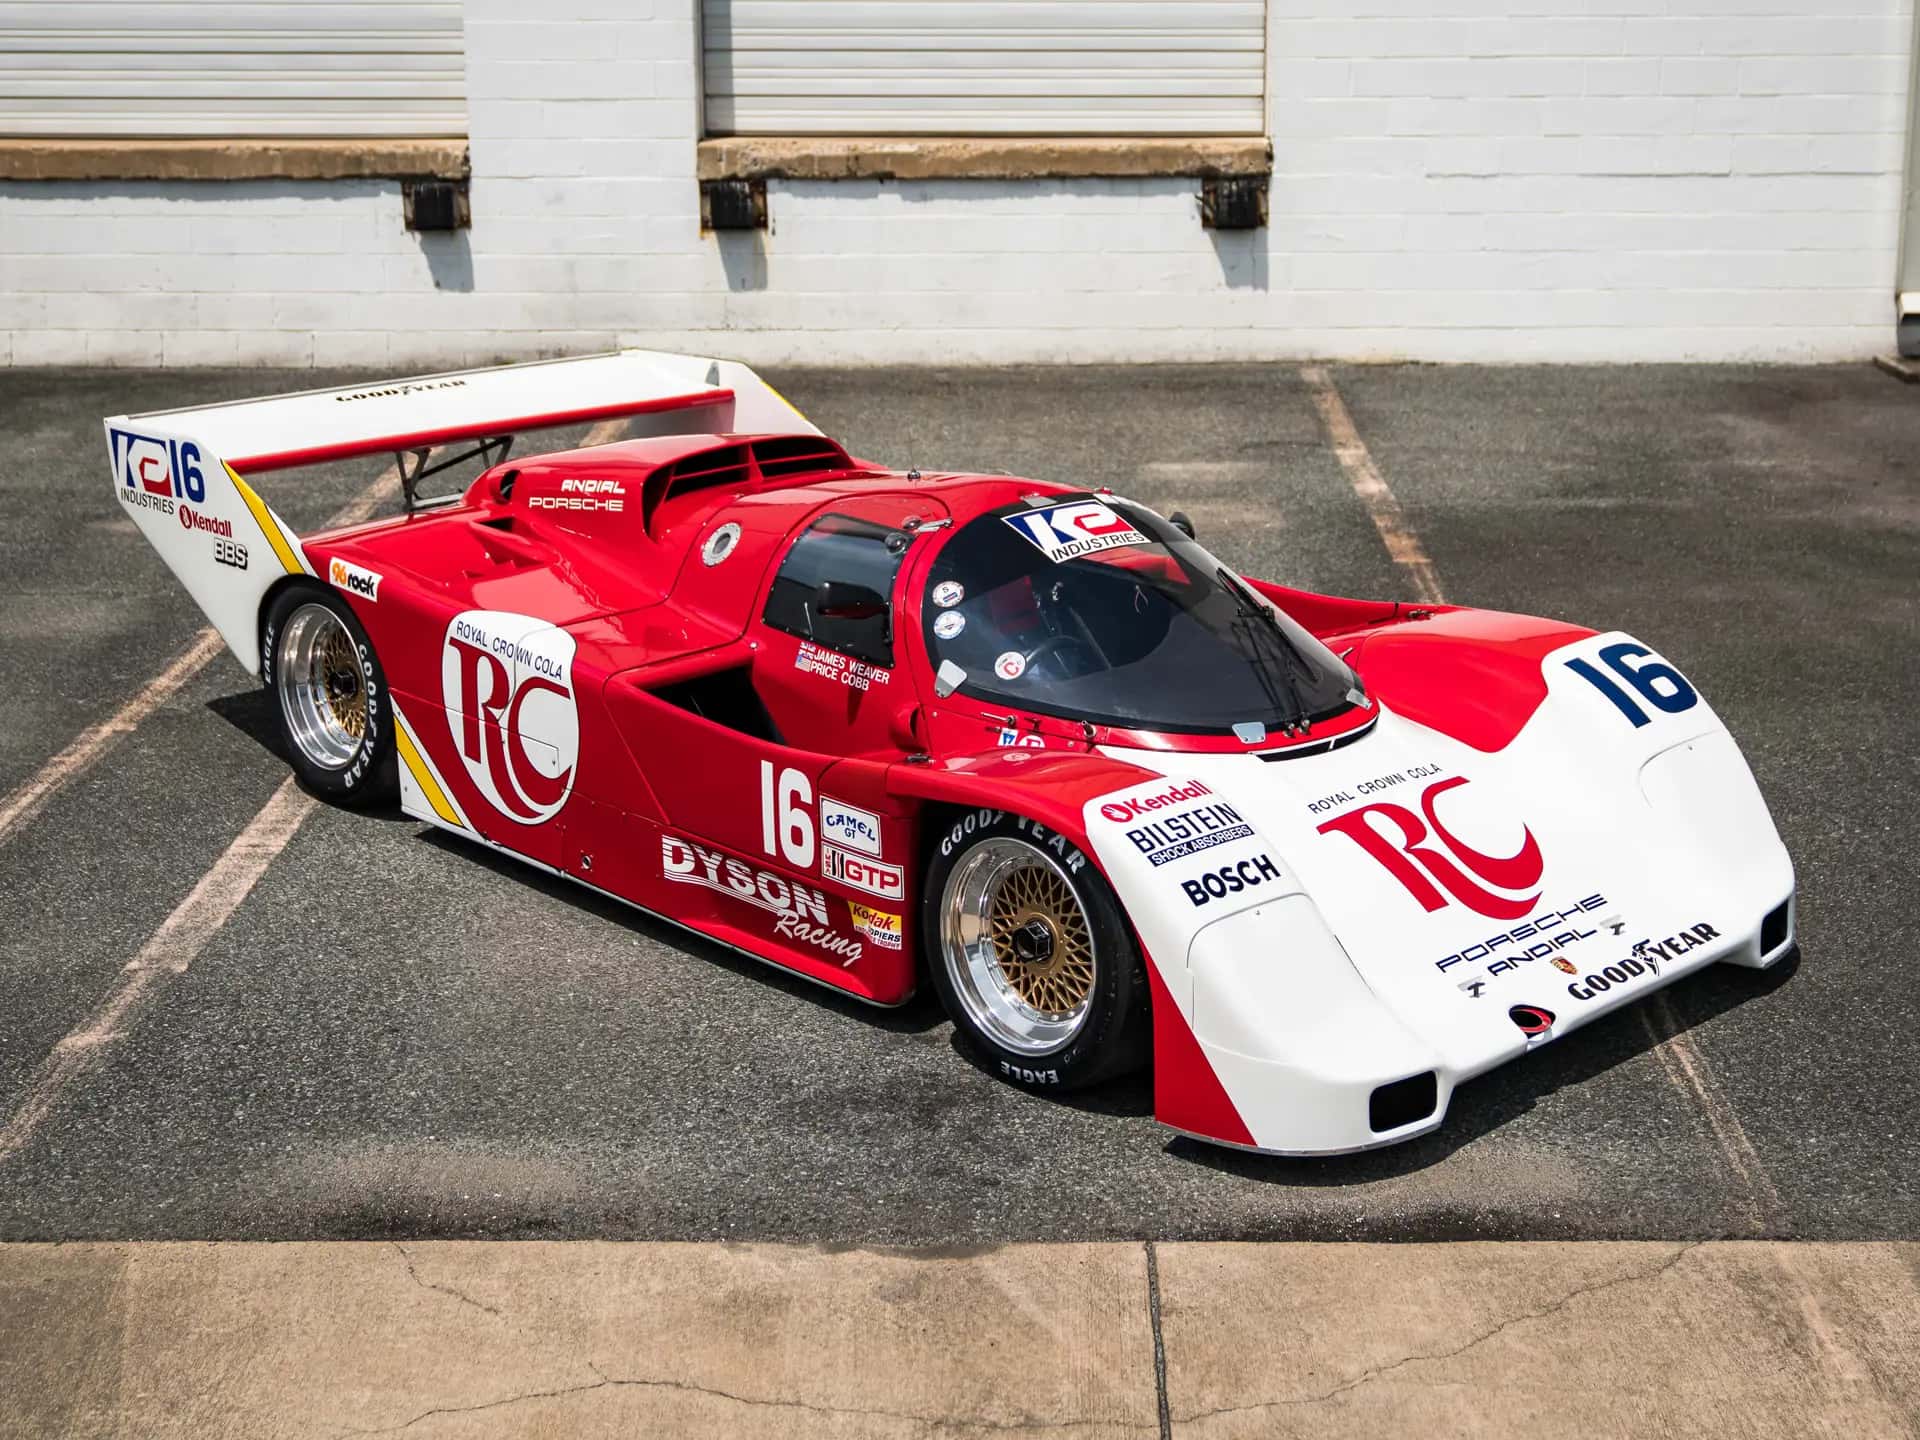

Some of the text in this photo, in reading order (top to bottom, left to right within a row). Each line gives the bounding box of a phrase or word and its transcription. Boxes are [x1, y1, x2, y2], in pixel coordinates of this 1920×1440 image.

[169, 439, 205, 503] 16
[561, 479, 626, 494] ANDIAL
[120, 488, 174, 515] INDUSTRIES
[529, 496, 624, 512] PORSCHE
[191, 510, 232, 538] Kendall
[214, 538, 248, 570] BBS
[1051, 532, 1145, 561] INDUSTRIES
[347, 572, 375, 597] rock
[456, 621, 563, 680] ROYAL CROWN COLA
[814, 649, 890, 685] JAMES WEAVER
[810, 661, 870, 691] PRICE COBB
[1563, 643, 1698, 728] 16
[448, 636, 572, 819] RC
[1123, 780, 1213, 814] Kendall
[1308, 763, 1442, 814] ROYAL CROWN COLA
[761, 760, 815, 868] 16
[826, 814, 875, 841] CAMEL
[1125, 803, 1244, 853] BILSTEIN
[844, 828, 856, 839] GT
[1151, 825, 1251, 865] SHOCK ABSORBERS
[1316, 776, 1543, 920] RC
[662, 834, 829, 926] DYSON
[845, 860, 900, 889] GTP
[1181, 854, 1280, 907] BOSCH
[853, 904, 895, 930] Kodak
[1435, 893, 1608, 973] PORSCHE
[774, 908, 862, 967] Racing
[1487, 928, 1598, 977] ANDIAL
[1000, 1060, 1059, 1084] EAGLE
